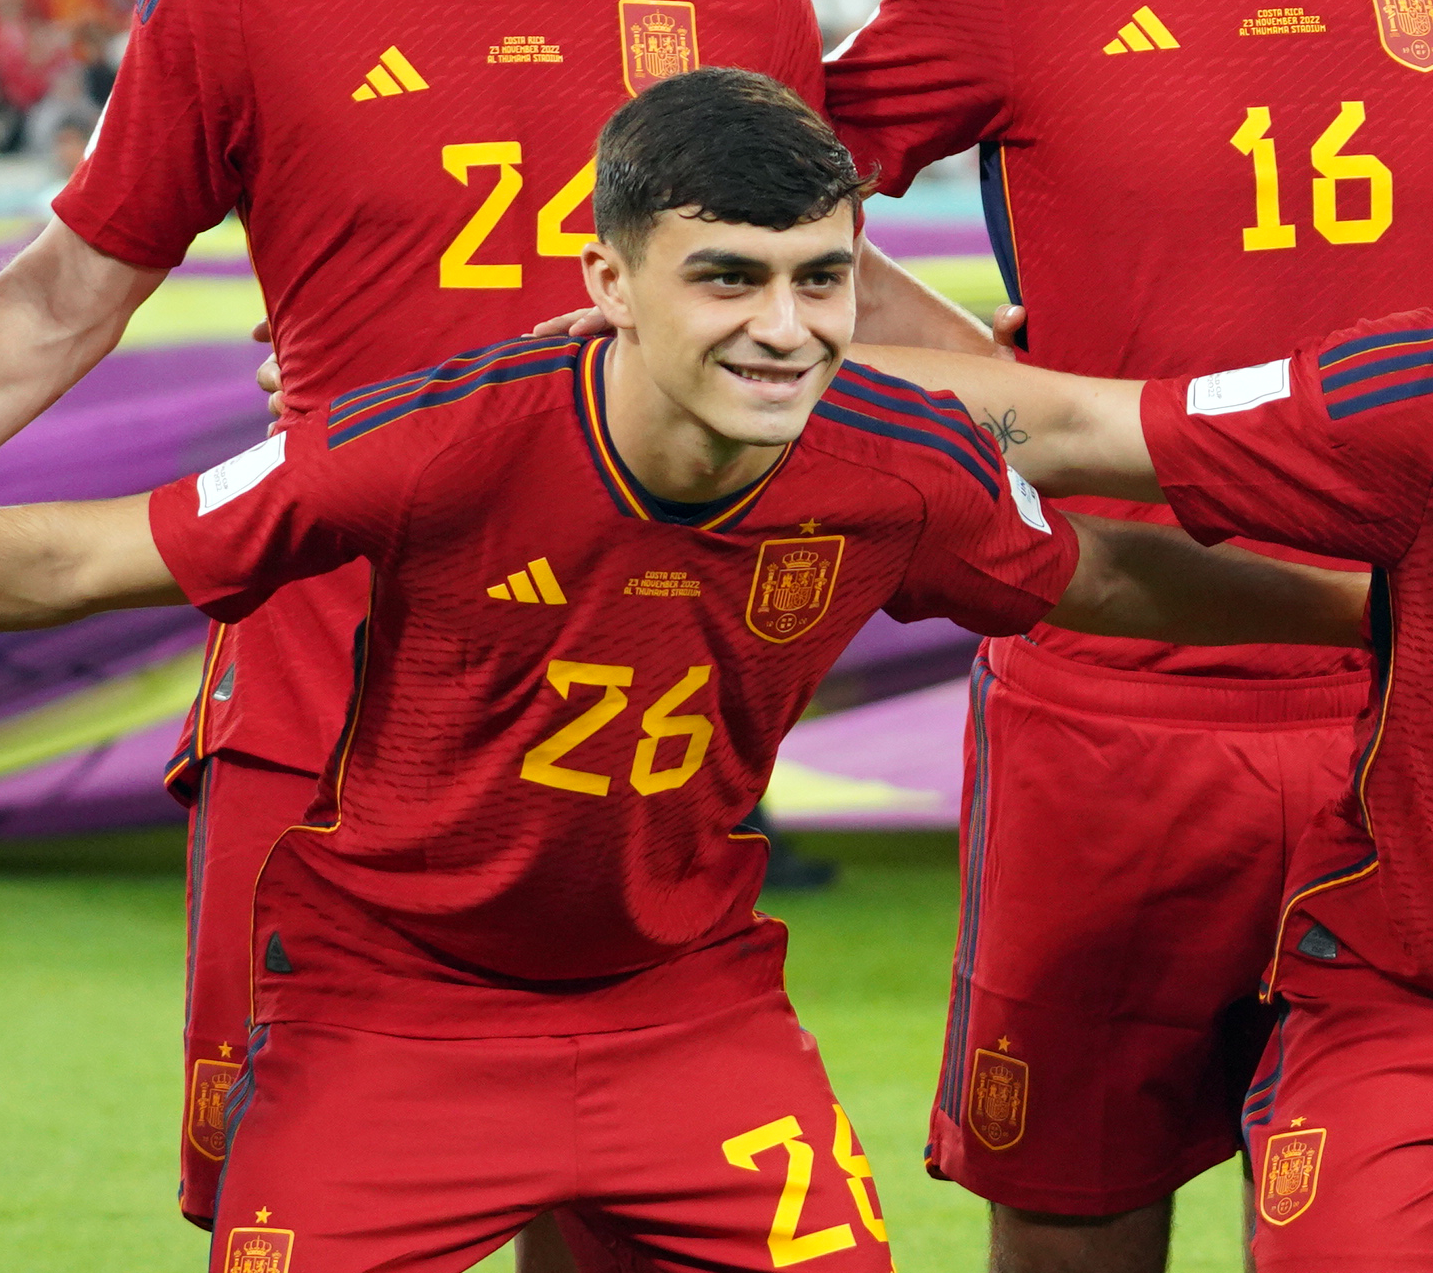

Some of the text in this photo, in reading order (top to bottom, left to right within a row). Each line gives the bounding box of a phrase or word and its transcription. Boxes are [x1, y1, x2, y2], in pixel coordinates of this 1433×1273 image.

[1257, 7, 1304, 18] COSTA RICA
[1242, 15, 1321, 28] 23 NOVEMBER 2022
[1239, 24, 1326, 36] AL THUMAMA STADIUM
[504, 36, 545, 45] COSTA RICA
[489, 45, 560, 55] 23 NOVEMBER 2022
[487, 54, 564, 64] AL THUMAMA STADIUM
[1230, 100, 1393, 251] 16
[645, 571, 687, 580] COSTA RICA
[628, 578, 701, 589] 23 NOVEMBER 2022
[623, 587, 701, 597] AL THUMAMA STADIUM
[519, 659, 714, 797] 26
